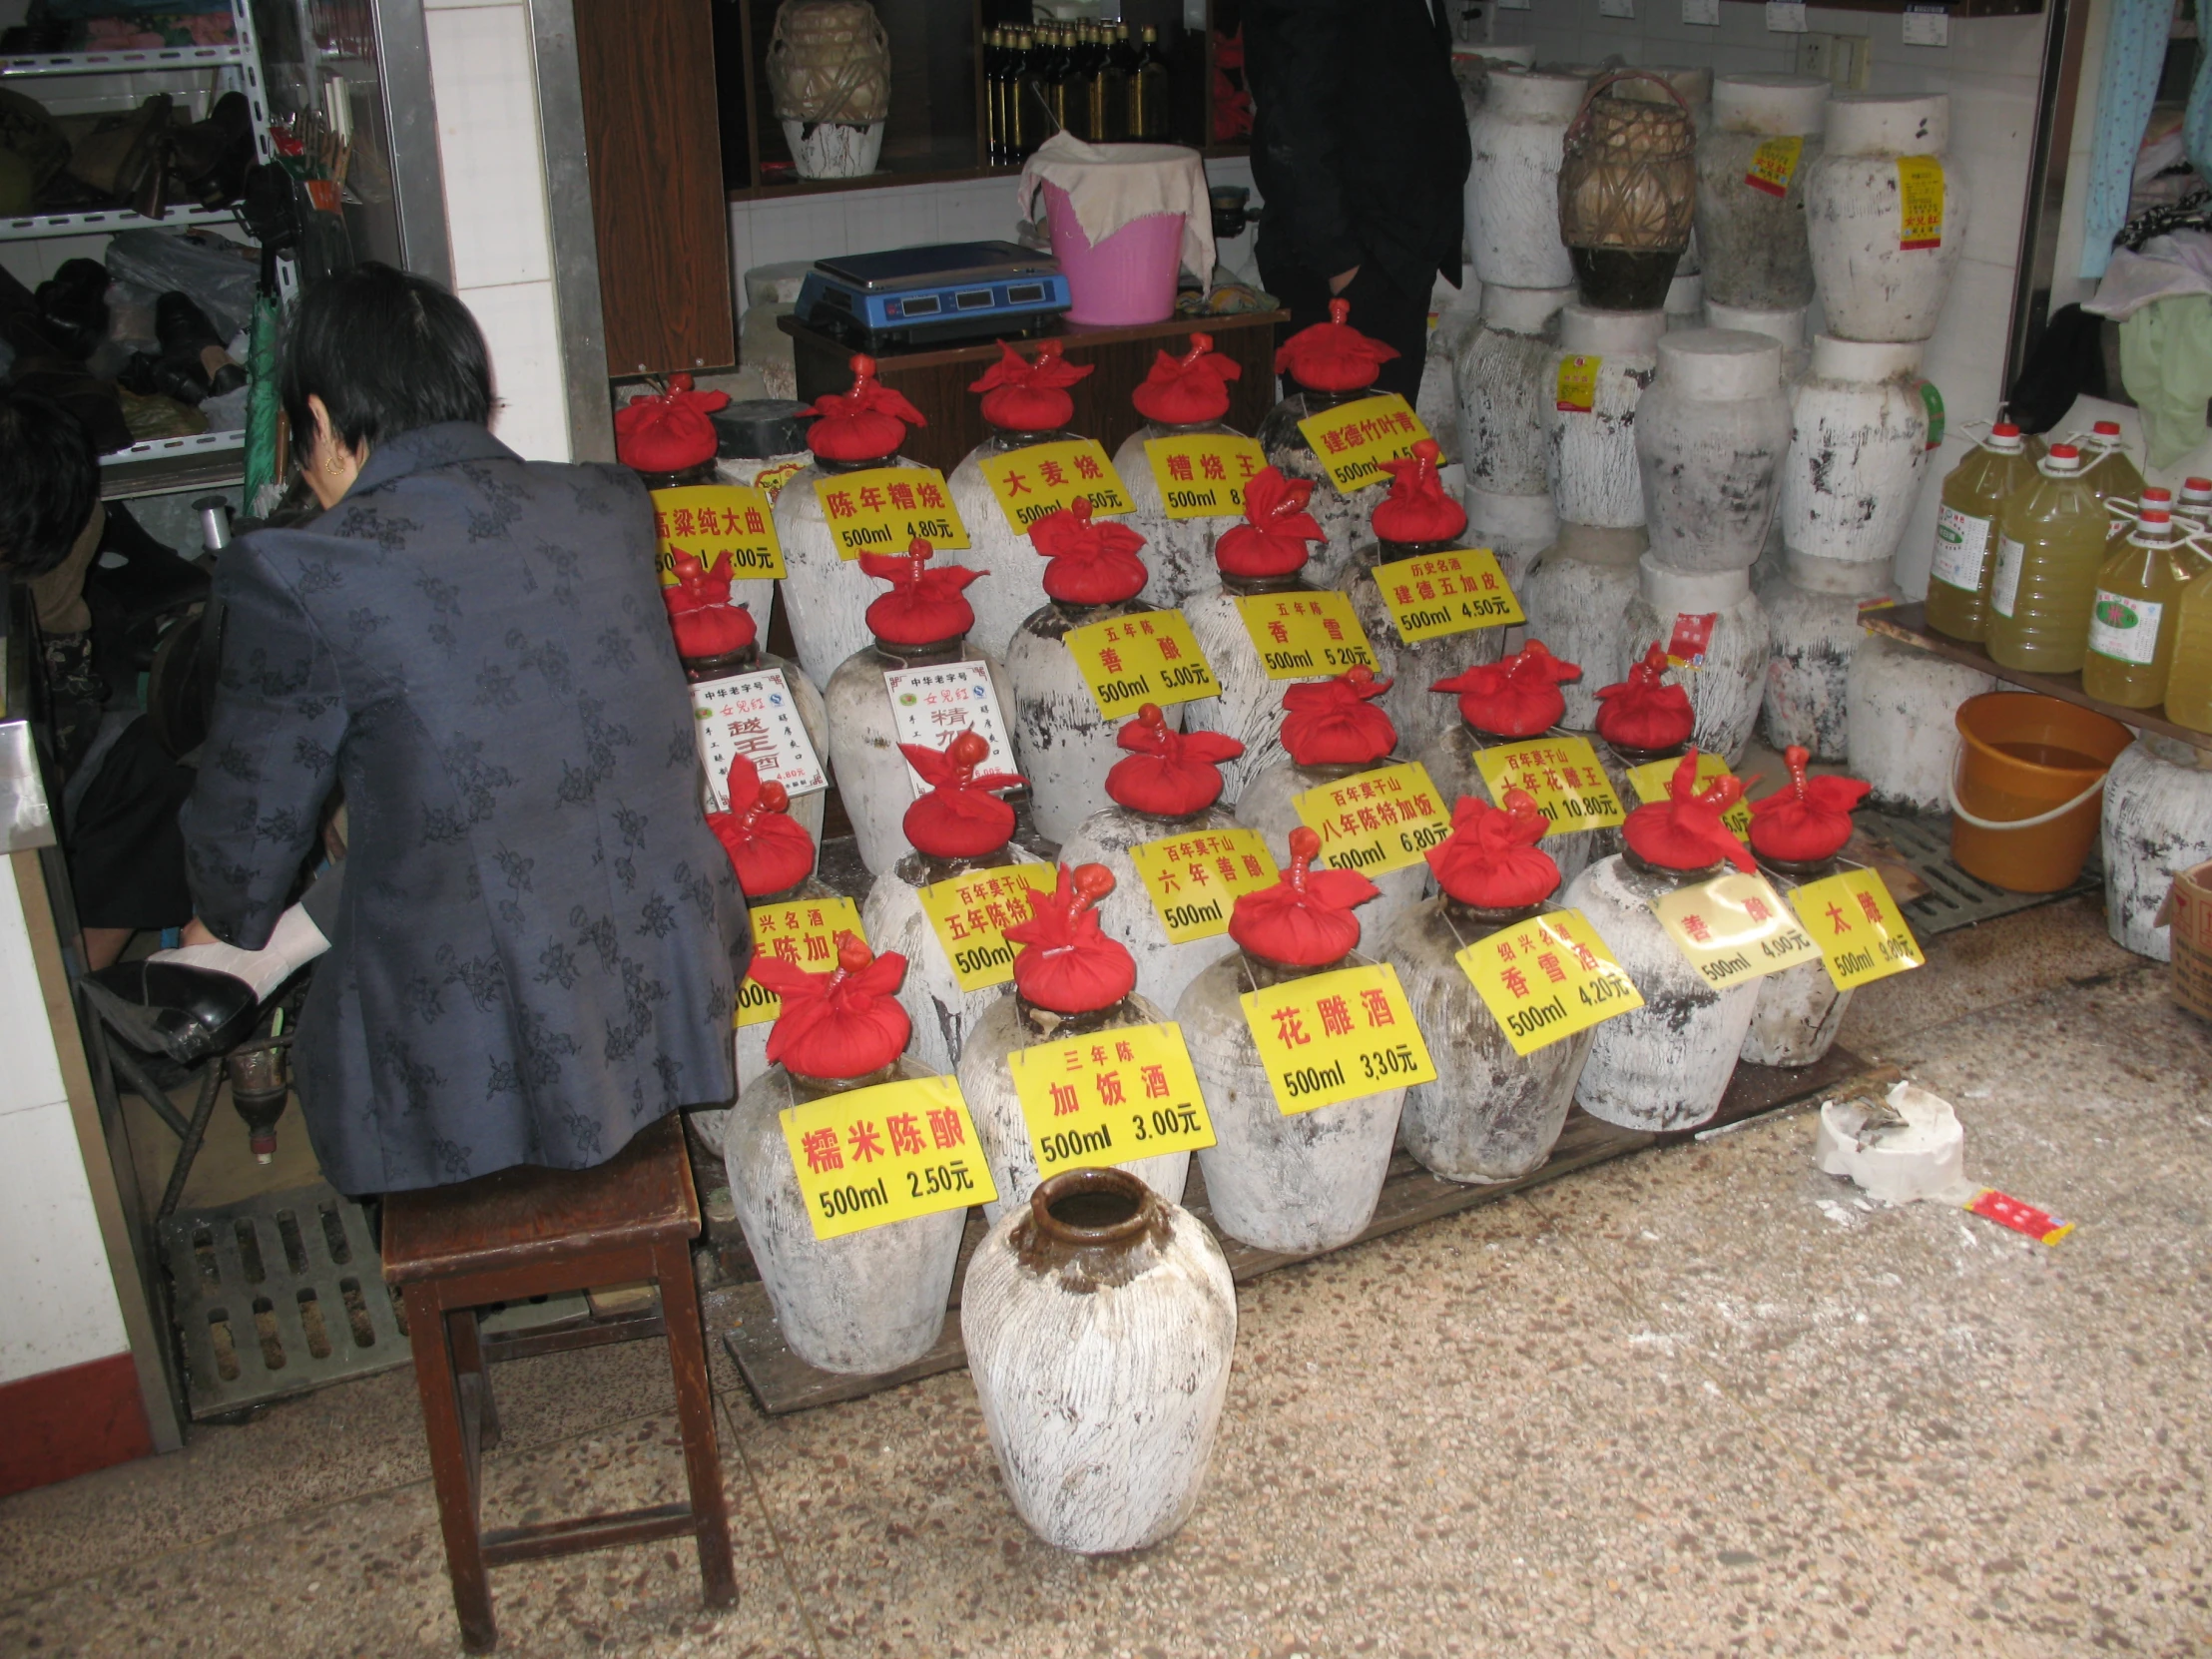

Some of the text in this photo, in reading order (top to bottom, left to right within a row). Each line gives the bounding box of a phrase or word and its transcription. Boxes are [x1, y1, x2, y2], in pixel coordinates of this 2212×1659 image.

[1320, 411, 1416, 455] 建德竹叶青
[1002, 454, 1104, 498] 大麦烧
[1166, 453, 1256, 481] 糟烧王
[1334, 455, 1380, 484] 500ml
[826, 482, 946, 519] 陈年糟烧
[1075, 489, 1123, 512] 50元
[1168, 488, 1217, 509] 500ml
[841, 518, 954, 548] 500ml 4.80元
[1410, 557, 1462, 577] 历史名酒
[1392, 571, 1499, 606] 建德五加皮
[1276, 601, 1324, 617] 五年陈
[1400, 596, 1510, 632] 500ml 4.50元
[1104, 619, 1155, 643] 五年陈
[1268, 618, 1345, 645] 香雪
[1098, 635, 1182, 675] 善酿
[1265, 649, 1314, 670] 500ml
[705, 681, 764, 701] 中华老字号
[910, 672, 968, 688] 中华老字号
[1097, 663, 1210, 704] 500ml 5.00元
[776, 768, 806, 781] 4.80元
[1504, 747, 1569, 771] 百年莫干山
[1330, 776, 1402, 808] 百年莫干山
[1500, 766, 1602, 795] 十年花雕王
[1322, 793, 1436, 842] 八年陈特加饭
[1562, 794, 1618, 819] 10.80元
[1163, 835, 1236, 862] 百年莫干山
[1328, 822, 1448, 871] 500ml 6.80元
[955, 873, 1032, 906] 百年莫干山
[1157, 853, 1265, 894] 六年善酿
[1164, 898, 1224, 929] 500ml
[1825, 889, 1885, 935] 太雕
[954, 938, 1016, 974] 500ml
[1496, 922, 1574, 963] 绍兴名酒
[1701, 928, 1812, 982] 500ml 4.00元
[1833, 933, 1916, 978] 500ml 9.80元
[1499, 941, 1601, 999] 香雪酒
[1271, 987, 1396, 1050] 花雕酒
[1506, 972, 1631, 1038] 500ml 4.20元
[1063, 1040, 1135, 1072] 三年陈
[1283, 1043, 1418, 1098] 500ml 3.30元
[1049, 1063, 1171, 1117] 加饭酒
[801, 1105, 966, 1175] 糯米陈酿
[1040, 1102, 1202, 1164] 500ml 3.00元
[819, 1159, 975, 1219] 500ml 2.50元
